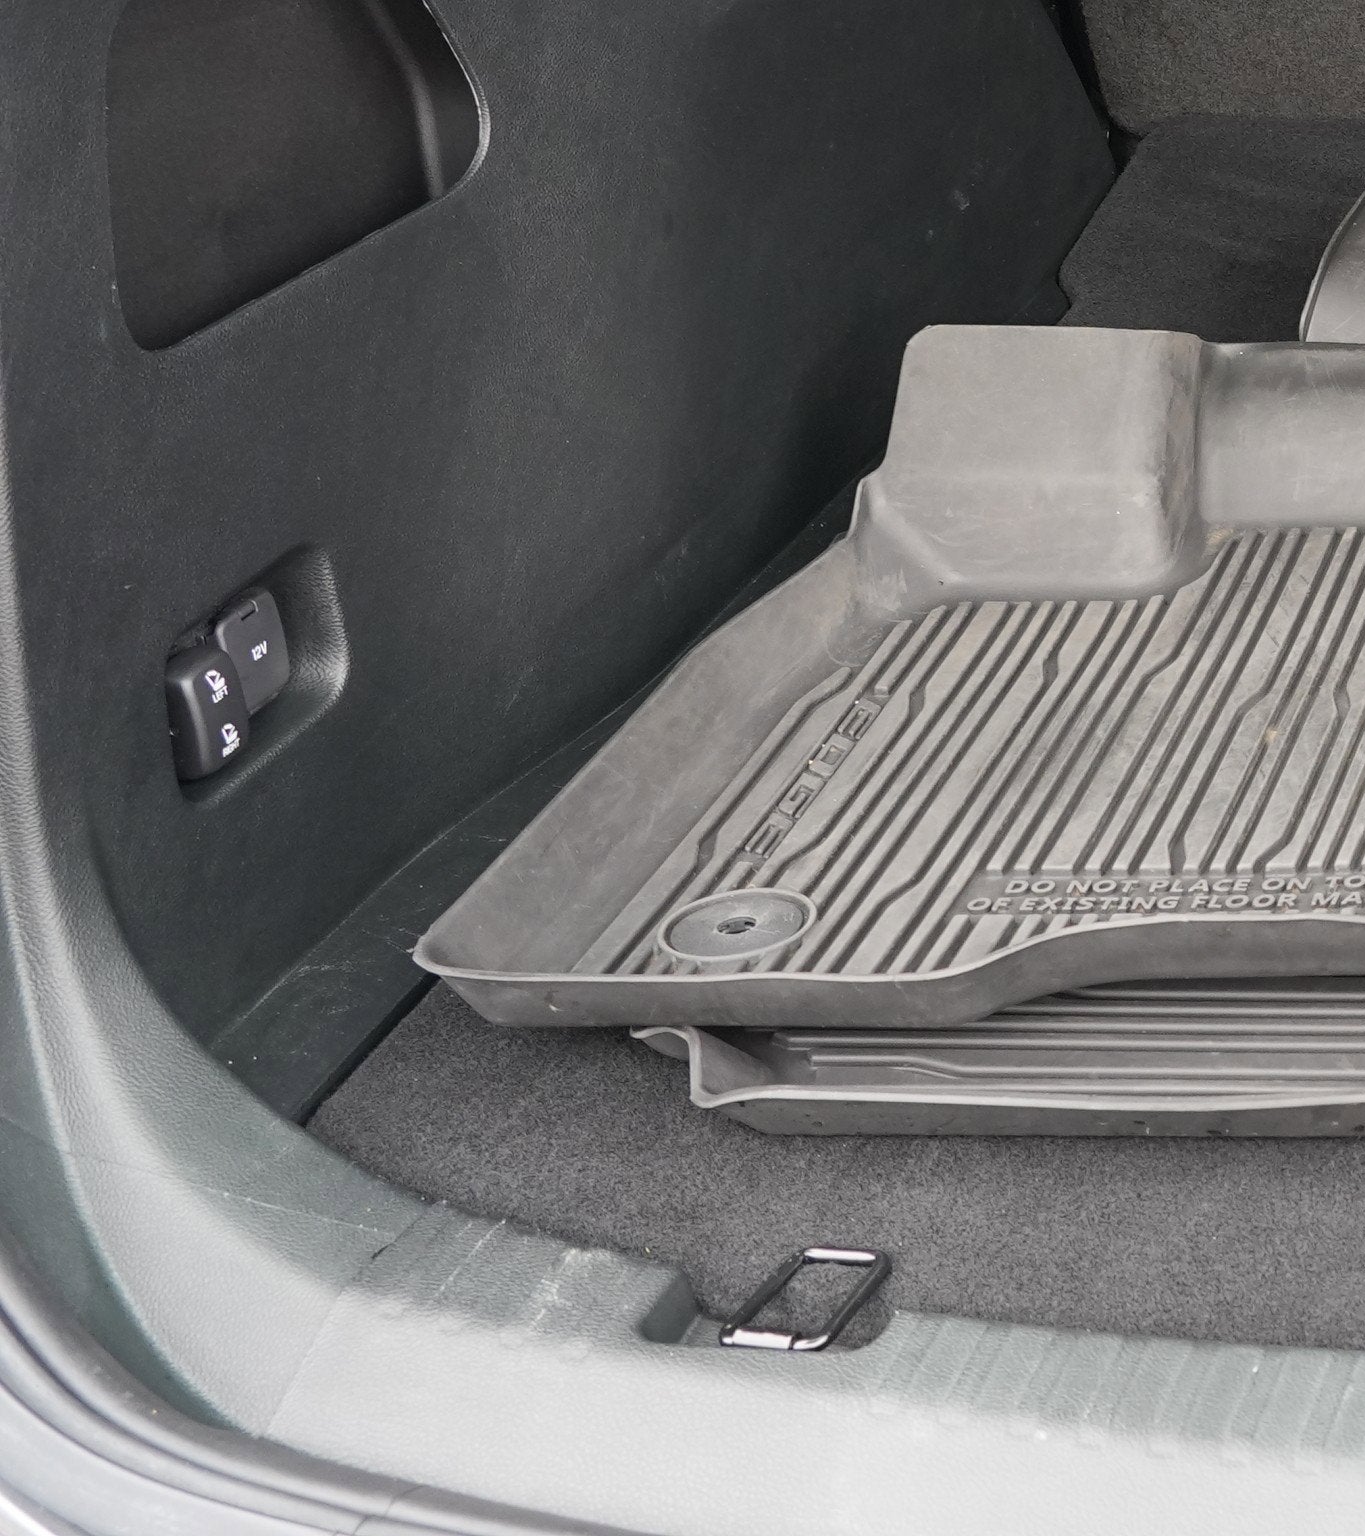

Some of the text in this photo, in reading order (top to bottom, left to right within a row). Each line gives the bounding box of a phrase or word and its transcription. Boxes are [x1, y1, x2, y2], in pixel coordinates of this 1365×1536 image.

[251, 640, 267, 661] 12V
[212, 687, 228, 703] LEFT
[1004, 879, 1056, 895] DO
[1065, 877, 1140, 894] NOT
[1148, 877, 1252, 893] PLACE
[1262, 876, 1313, 892] ON
[965, 896, 1014, 914] OF
[1018, 895, 1183, 912] EXISTING
[1190, 892, 1299, 910] FLOOR
